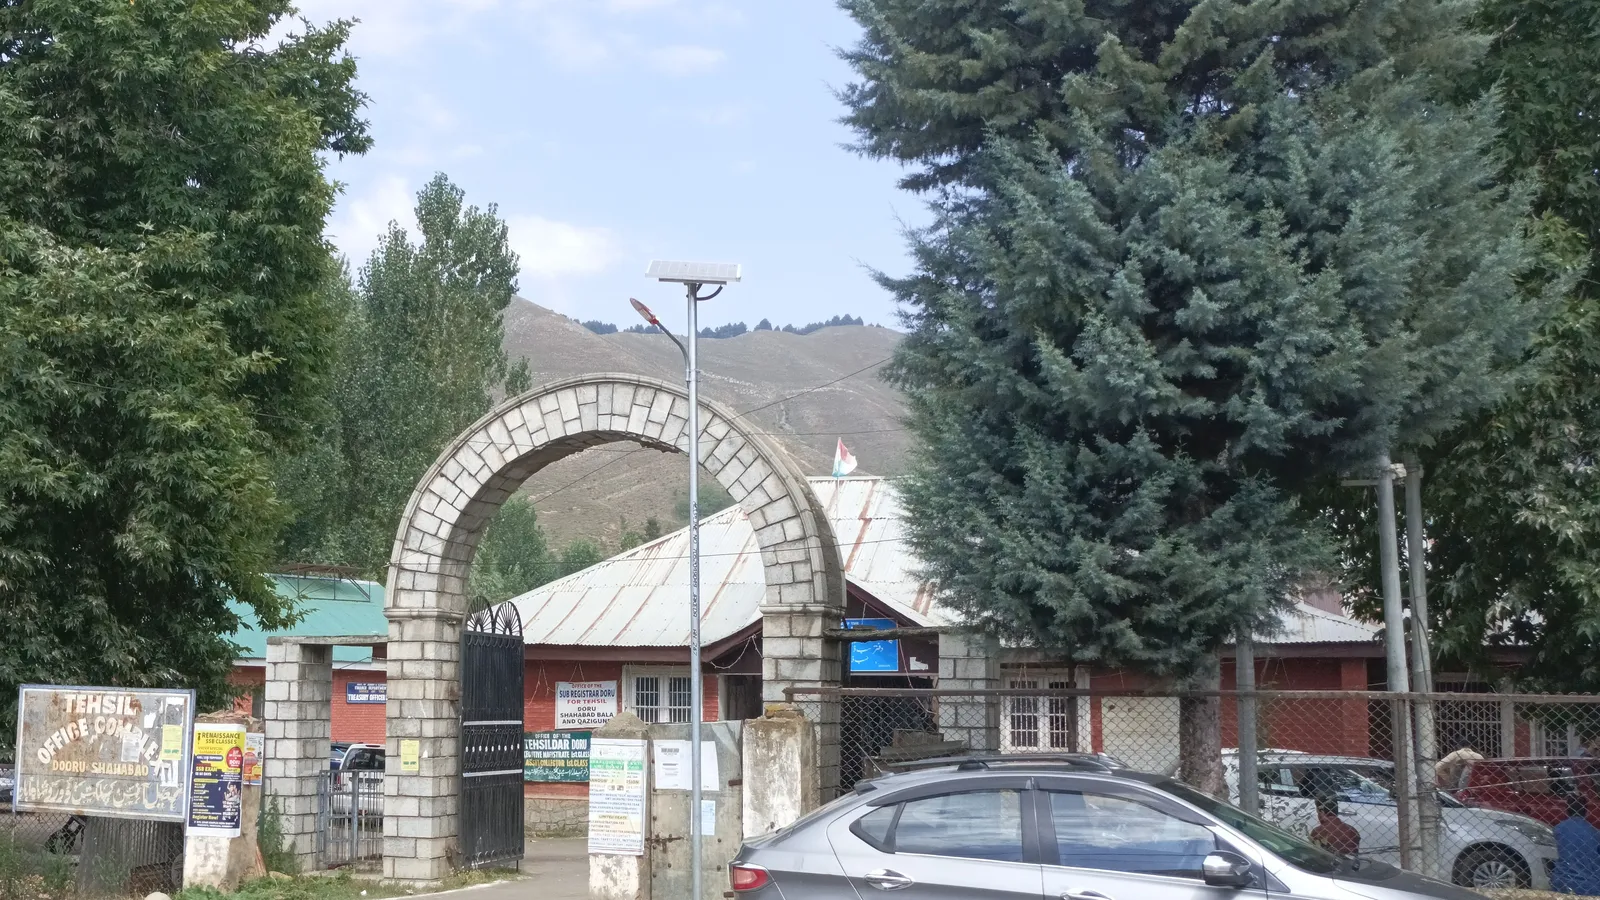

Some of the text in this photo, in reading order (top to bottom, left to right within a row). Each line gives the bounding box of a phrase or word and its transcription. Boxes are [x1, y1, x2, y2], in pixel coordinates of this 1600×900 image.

[560, 689, 616, 698] SUB REGISTRAR DORU
[64, 694, 138, 716] TEHSIL
[37, 718, 89, 764] OFFICE
[524, 739, 587, 750] TEHSILDAR DORU
[52, 760, 149, 777] DOORU SHAHABAD
